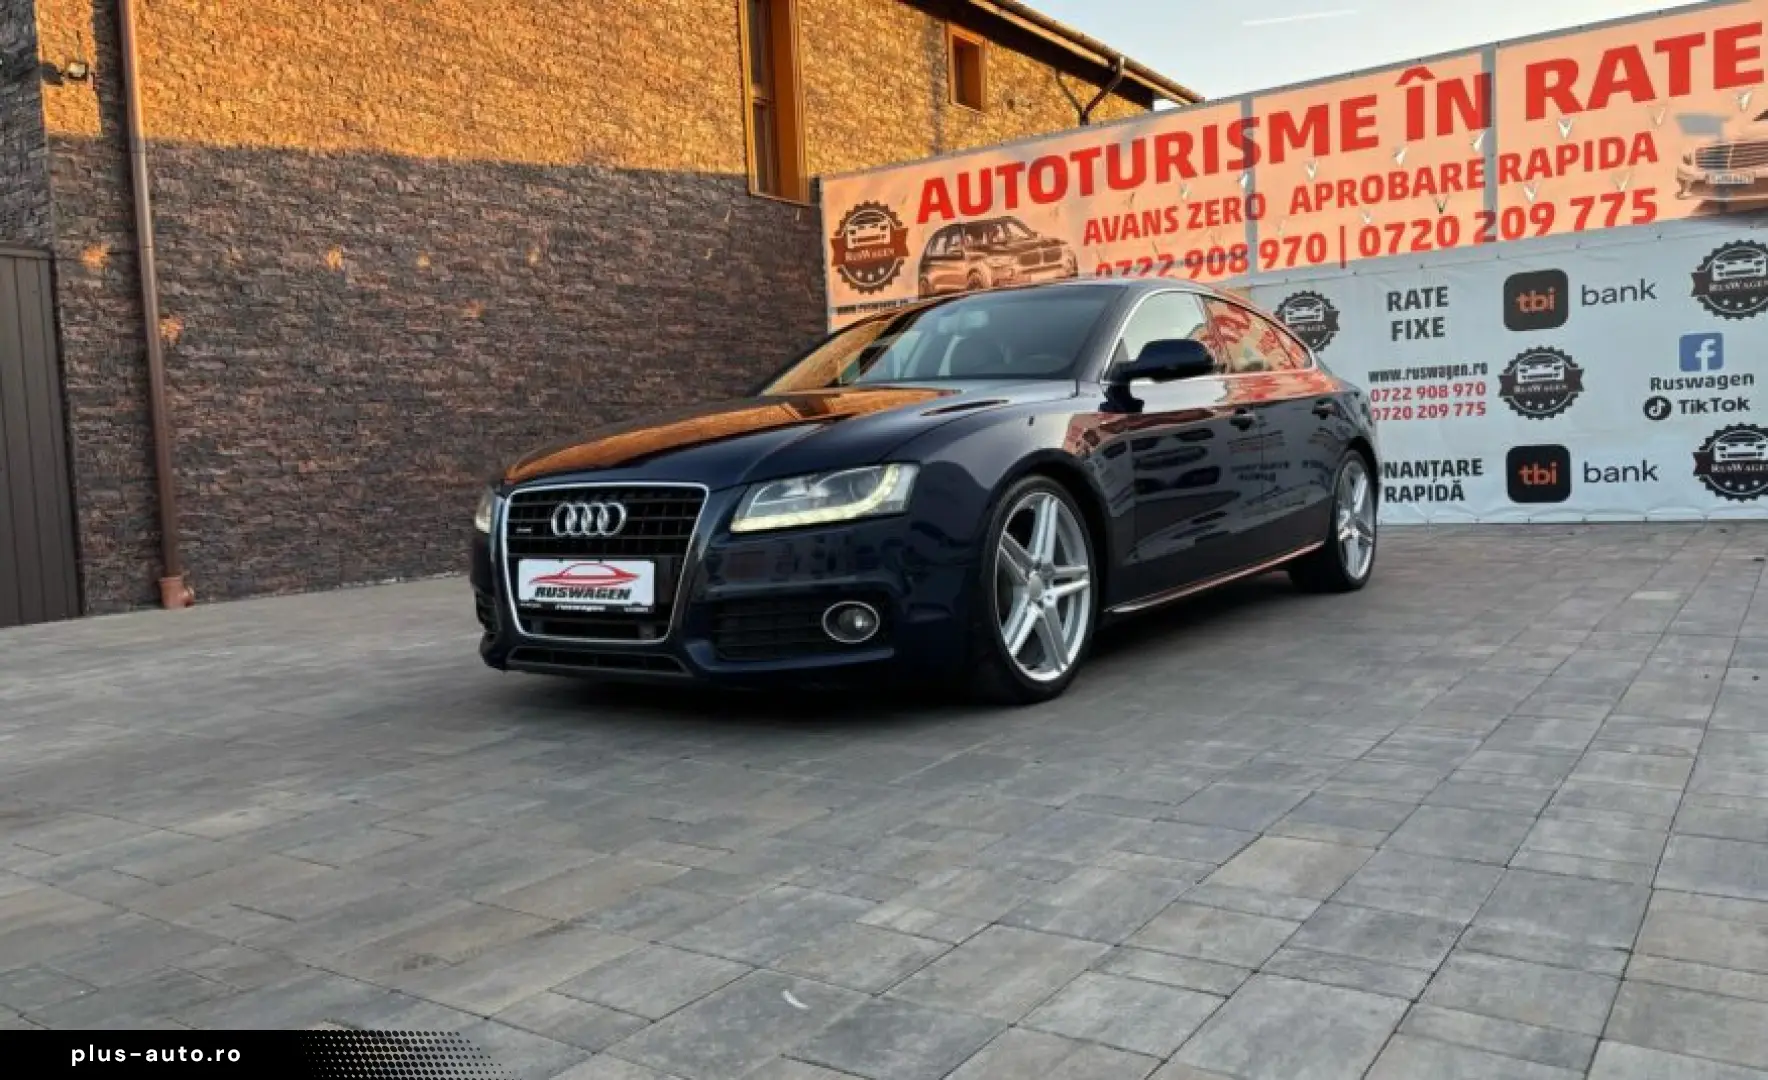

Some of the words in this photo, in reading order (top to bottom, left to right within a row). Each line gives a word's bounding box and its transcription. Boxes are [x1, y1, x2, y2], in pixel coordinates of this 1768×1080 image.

[917, 94, 1379, 225] AUTOTURISME
[1395, 66, 1492, 142] ÎN
[1525, 21, 1765, 121] RATE
[1083, 205, 1179, 246] AVANS
[1187, 193, 1266, 230] ZERO
[1289, 157, 1486, 217] APROBARE
[1498, 131, 1658, 185] RAPIDA
[1184, 243, 1249, 279] 908
[1258, 233, 1327, 270] 970
[1358, 214, 1460, 257] 0720
[1473, 201, 1556, 244] 209
[1570, 188, 1657, 231] 775
[1386, 286, 1449, 312] RATE
[1516, 287, 1555, 313] tbi
[1581, 278, 1657, 307] bank
[1391, 316, 1446, 341] FIXE
[1368, 362, 1488, 383] www.ruswagen.ro
[1650, 373, 1754, 392] Ruswagen
[1370, 387, 1412, 402] 0722
[1416, 384, 1449, 400] 908
[1453, 381, 1486, 397] 970
[1371, 405, 1412, 421] 0720
[1417, 403, 1449, 419] 209
[1453, 401, 1486, 417] 775
[1678, 397, 1750, 414] TikTok
[1380, 457, 1484, 484] NANȚARE
[1518, 461, 1557, 486] tbi
[1583, 459, 1660, 484] bank
[1384, 480, 1466, 503] RAPIDĂ
[534, 586, 632, 600] RUSWAGEN
